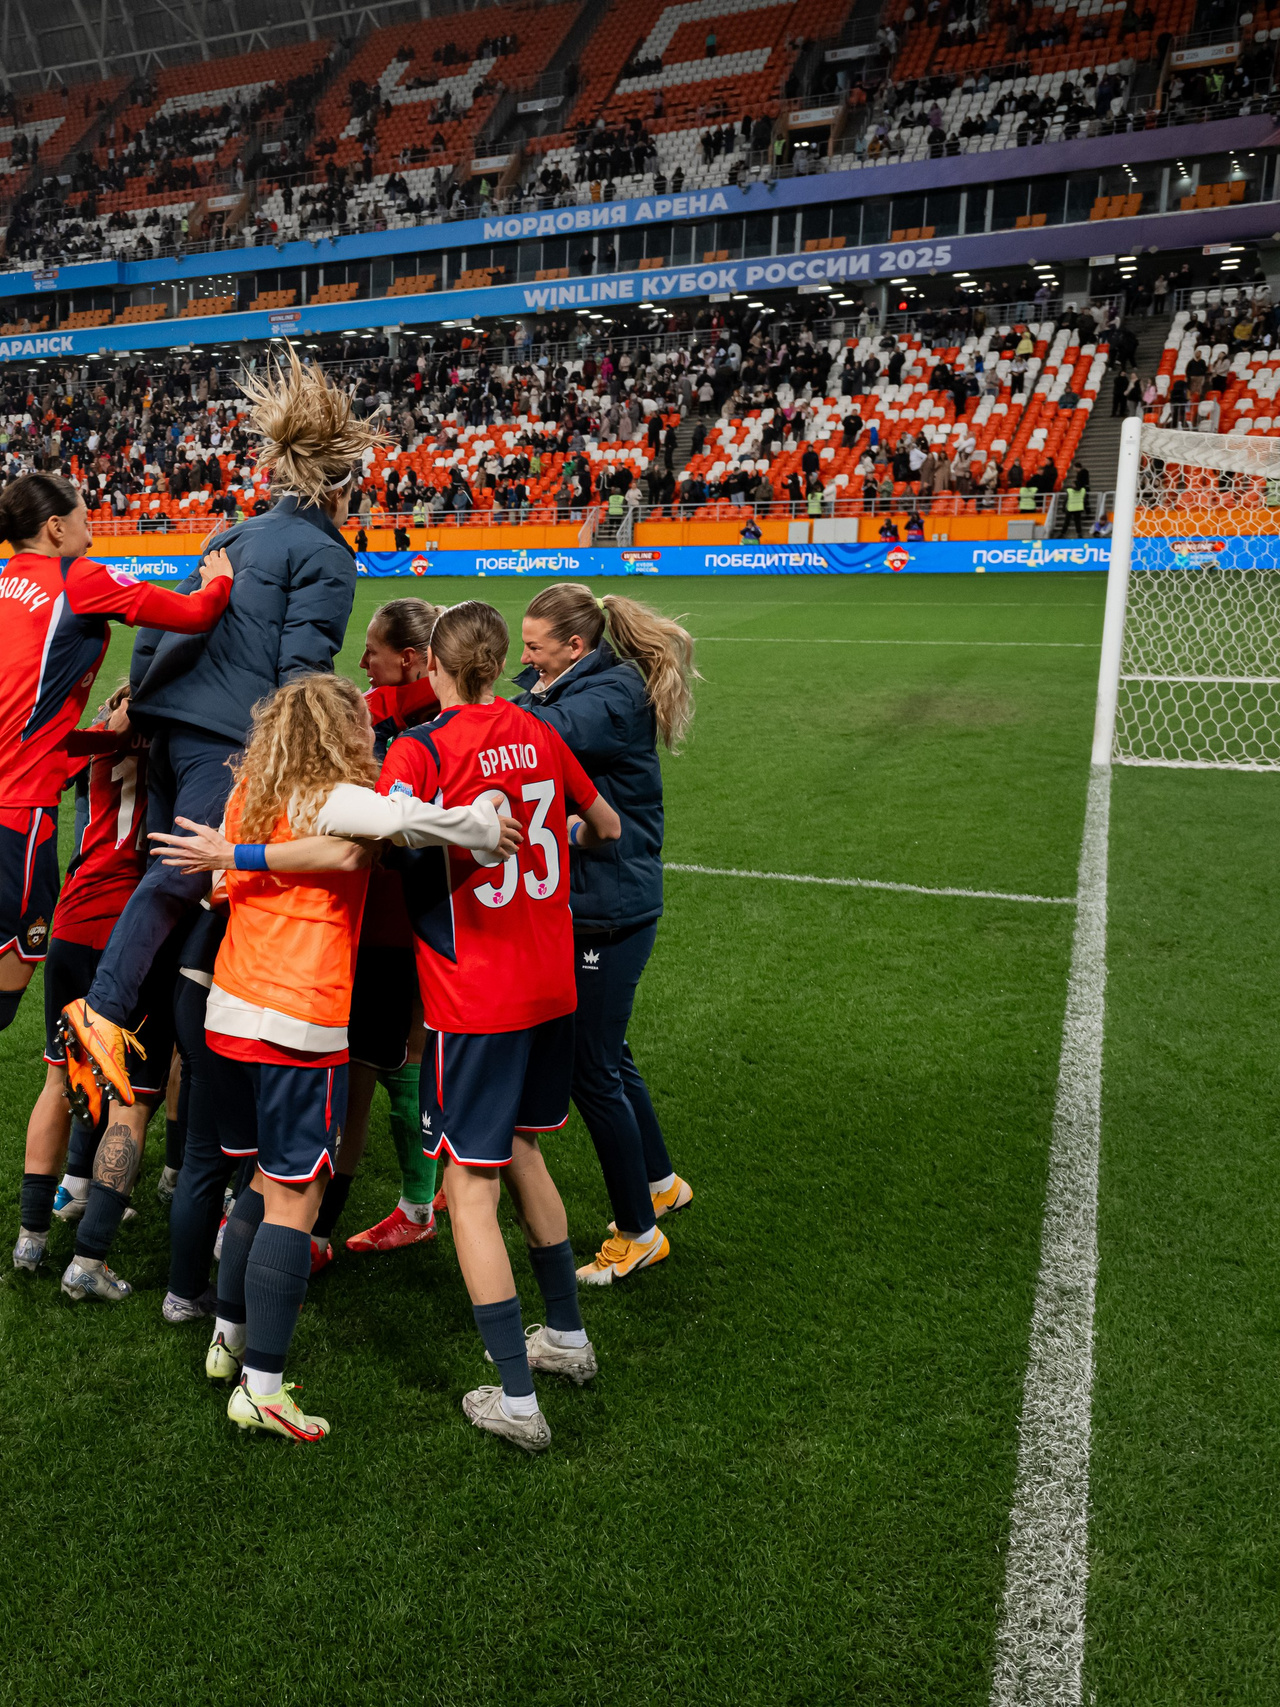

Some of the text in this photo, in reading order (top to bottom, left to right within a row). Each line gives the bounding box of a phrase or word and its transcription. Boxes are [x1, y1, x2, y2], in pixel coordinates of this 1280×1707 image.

[484, 192, 728, 240] МОРДОВИЯ АРЕНА
[523, 245, 952, 309] WINLINE КУБОК РОССИИ 2025
[106, 562, 178, 575] ОБЕДИТЕЛЬ
[476, 556, 579, 571] ПОБЕДИТЕЛЬ
[704, 553, 824, 569] ПОБЕДИТЕЛЬ
[972, 547, 1111, 567] ПОБЕДИТЕЛЬ
[111, 755, 149, 850] 1
[471, 778, 560, 908] 93
